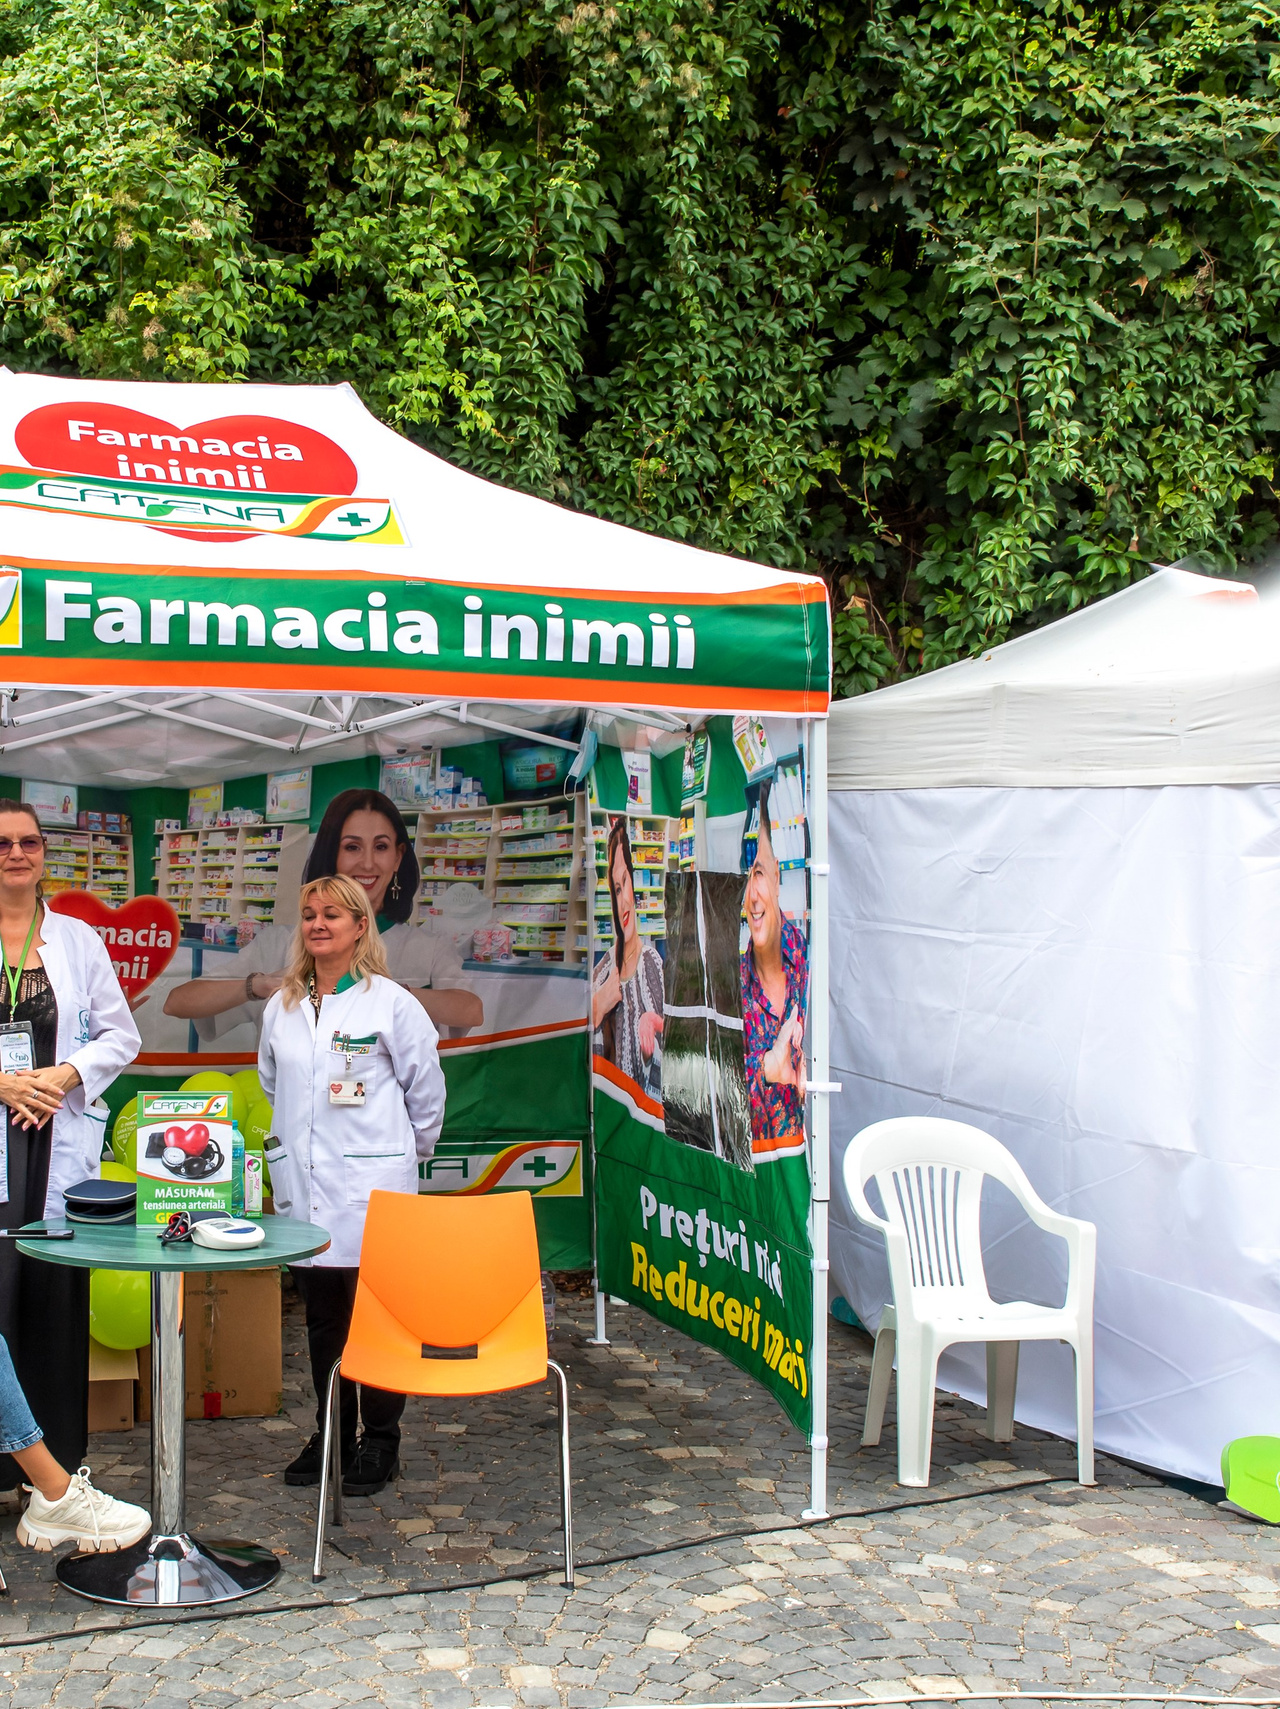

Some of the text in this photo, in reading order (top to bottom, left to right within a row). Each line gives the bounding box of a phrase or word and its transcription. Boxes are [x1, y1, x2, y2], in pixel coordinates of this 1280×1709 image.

[67, 419, 304, 463] Farmacia
[116, 454, 268, 490] inimii
[37, 482, 287, 525] CATENA
[44, 579, 696, 670] Farmacia inimii
[91, 922, 173, 949] macia
[152, 1101, 204, 1112] CATENA
[143, 1199, 226, 1211] tensiunea arterială
[155, 1186, 215, 1199] MĂSURĂM
[631, 1242, 761, 1351] Reduceri
